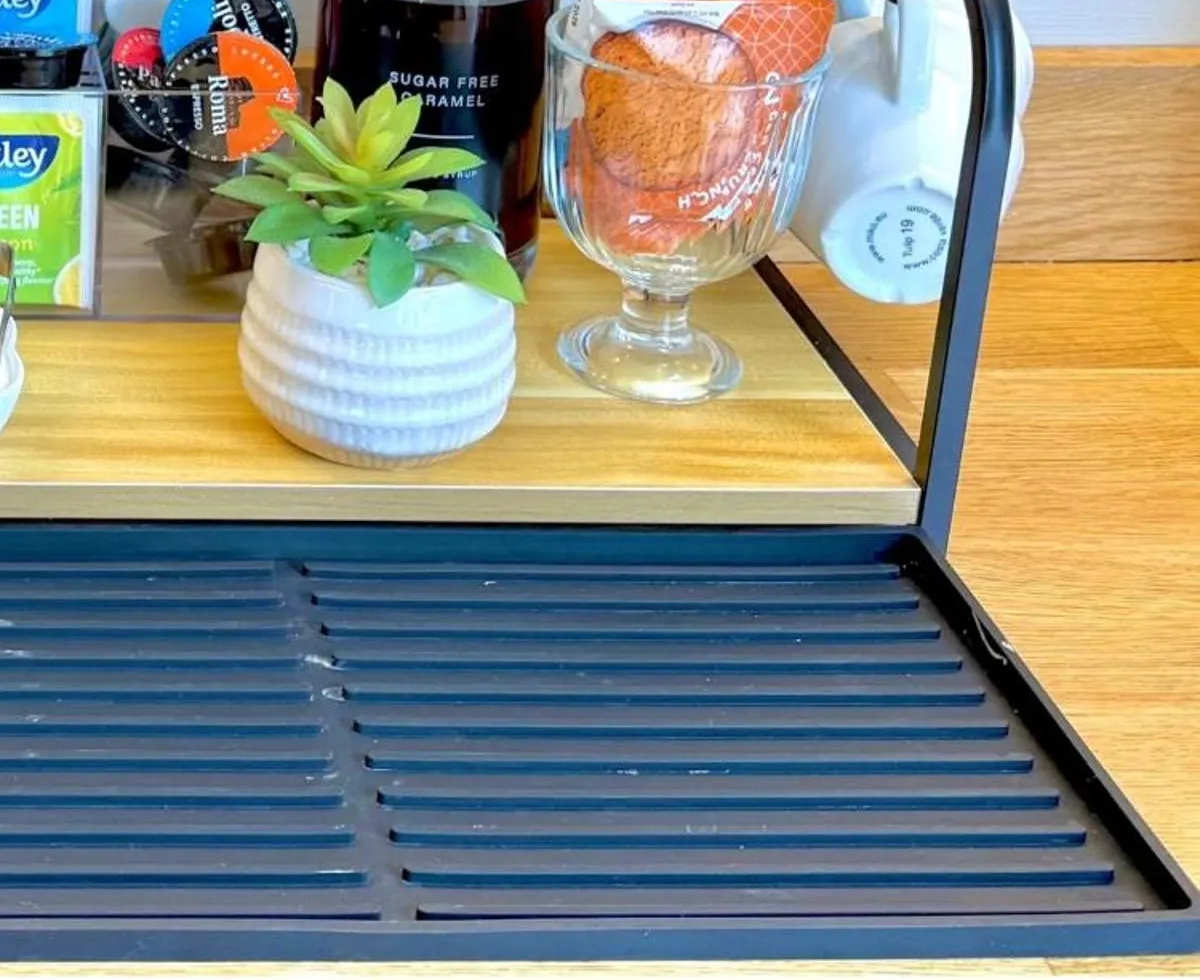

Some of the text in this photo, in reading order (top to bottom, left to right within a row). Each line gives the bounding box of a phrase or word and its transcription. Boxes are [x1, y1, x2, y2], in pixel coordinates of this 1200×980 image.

[389, 70, 500, 89] SUGAR FREE
[400, 91, 487, 108] CRAMEL
[190, 83, 204, 131] ESPRESSO
[207, 75, 229, 136] Roma
[900, 218, 916, 258] Tulip 19
